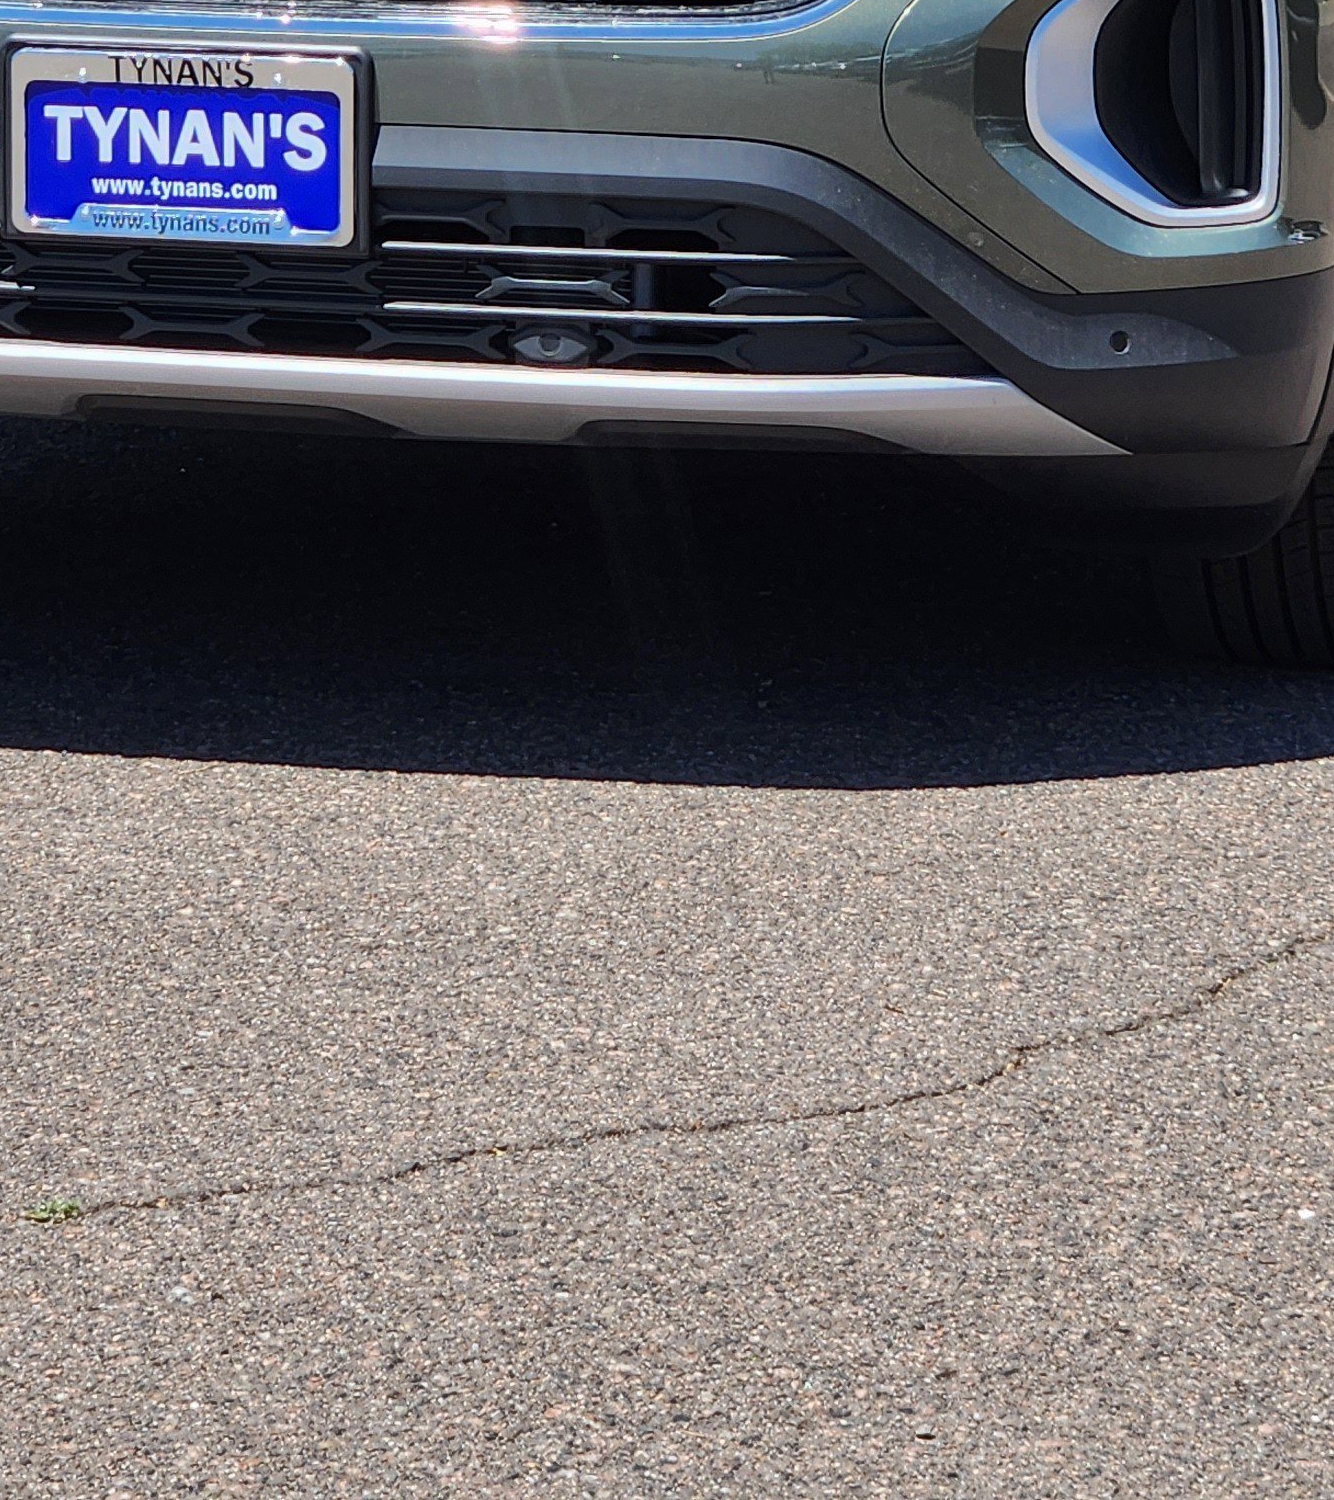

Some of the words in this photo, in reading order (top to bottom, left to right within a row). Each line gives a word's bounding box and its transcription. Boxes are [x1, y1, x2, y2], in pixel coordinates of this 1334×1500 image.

[108, 55, 255, 88] TYNAN'S
[43, 104, 328, 172] TYNAN'S
[92, 175, 278, 201] www.tynans.com
[92, 209, 272, 236] www.tynans.com
